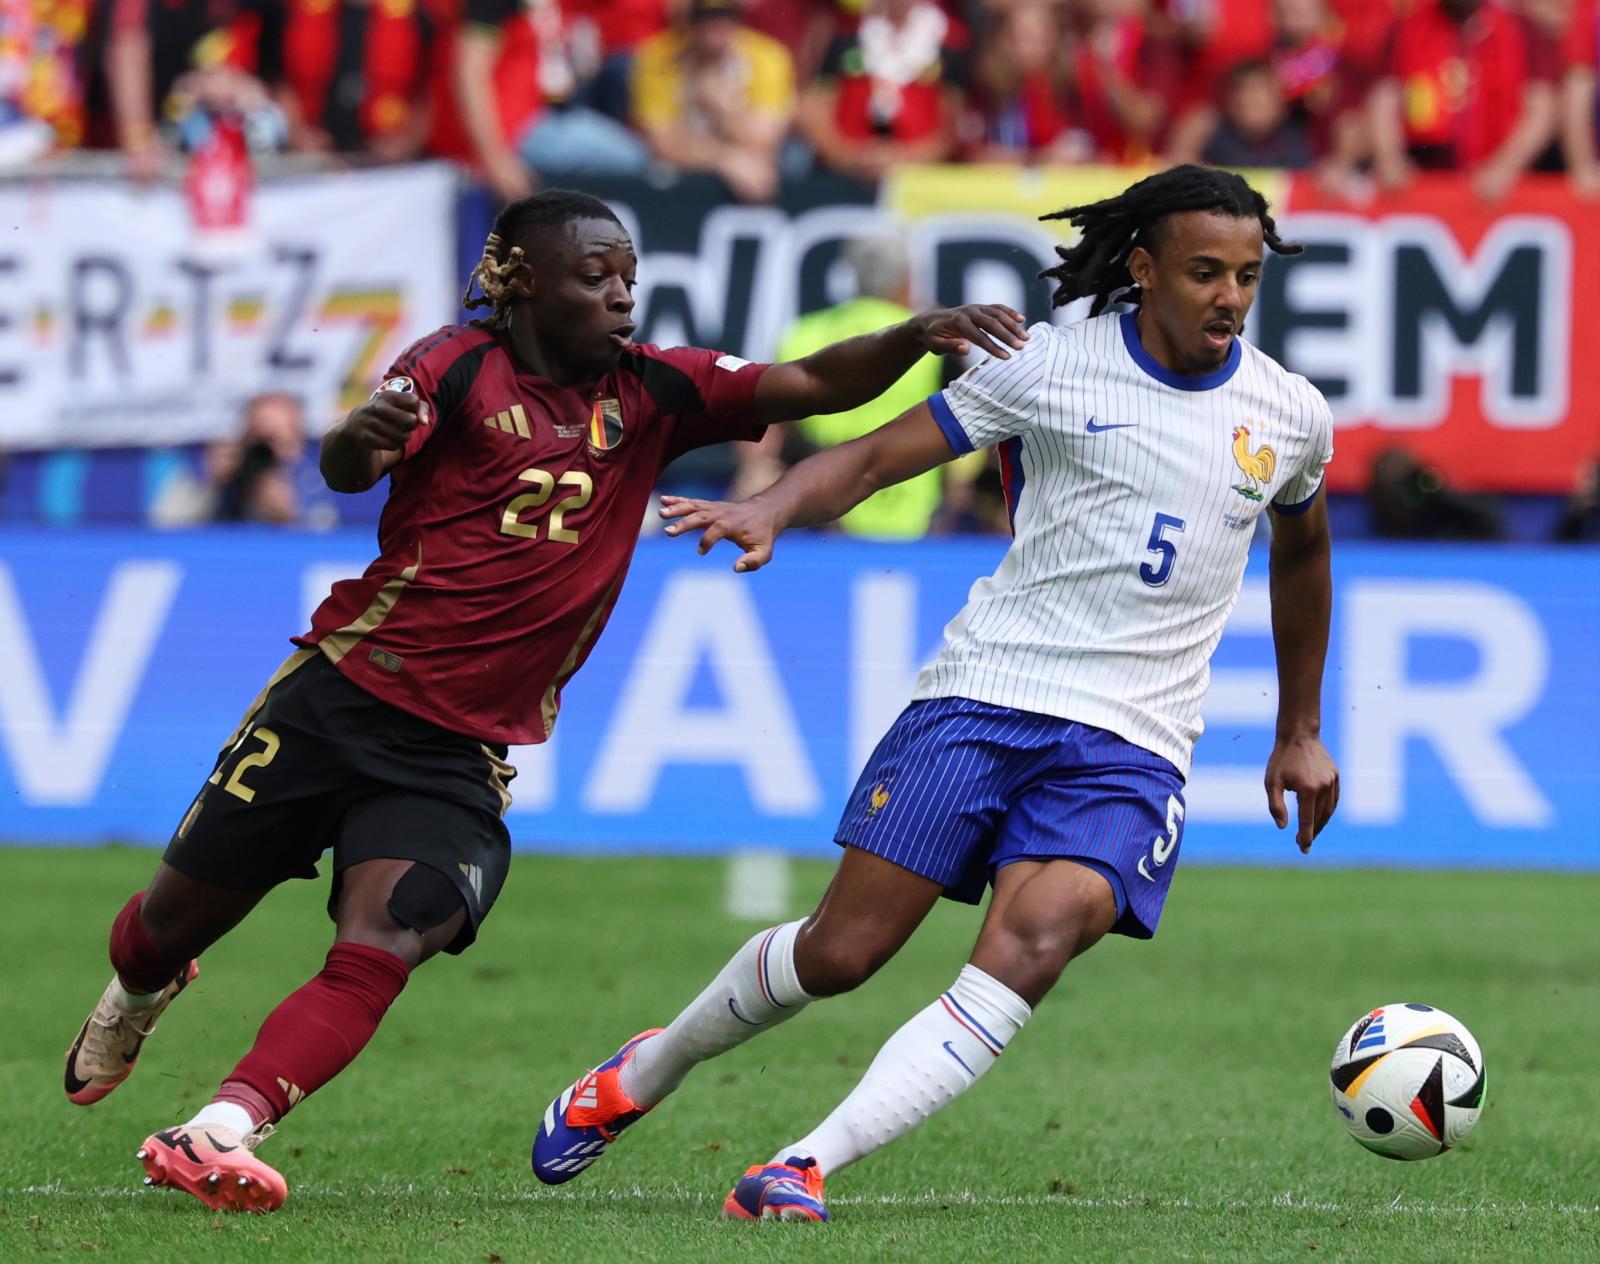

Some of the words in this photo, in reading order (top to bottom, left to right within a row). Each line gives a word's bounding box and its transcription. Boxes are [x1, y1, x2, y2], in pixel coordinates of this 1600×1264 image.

[500, 467, 593, 544] 22
[1139, 511, 1186, 588] 5
[1153, 793, 1185, 867] 5
